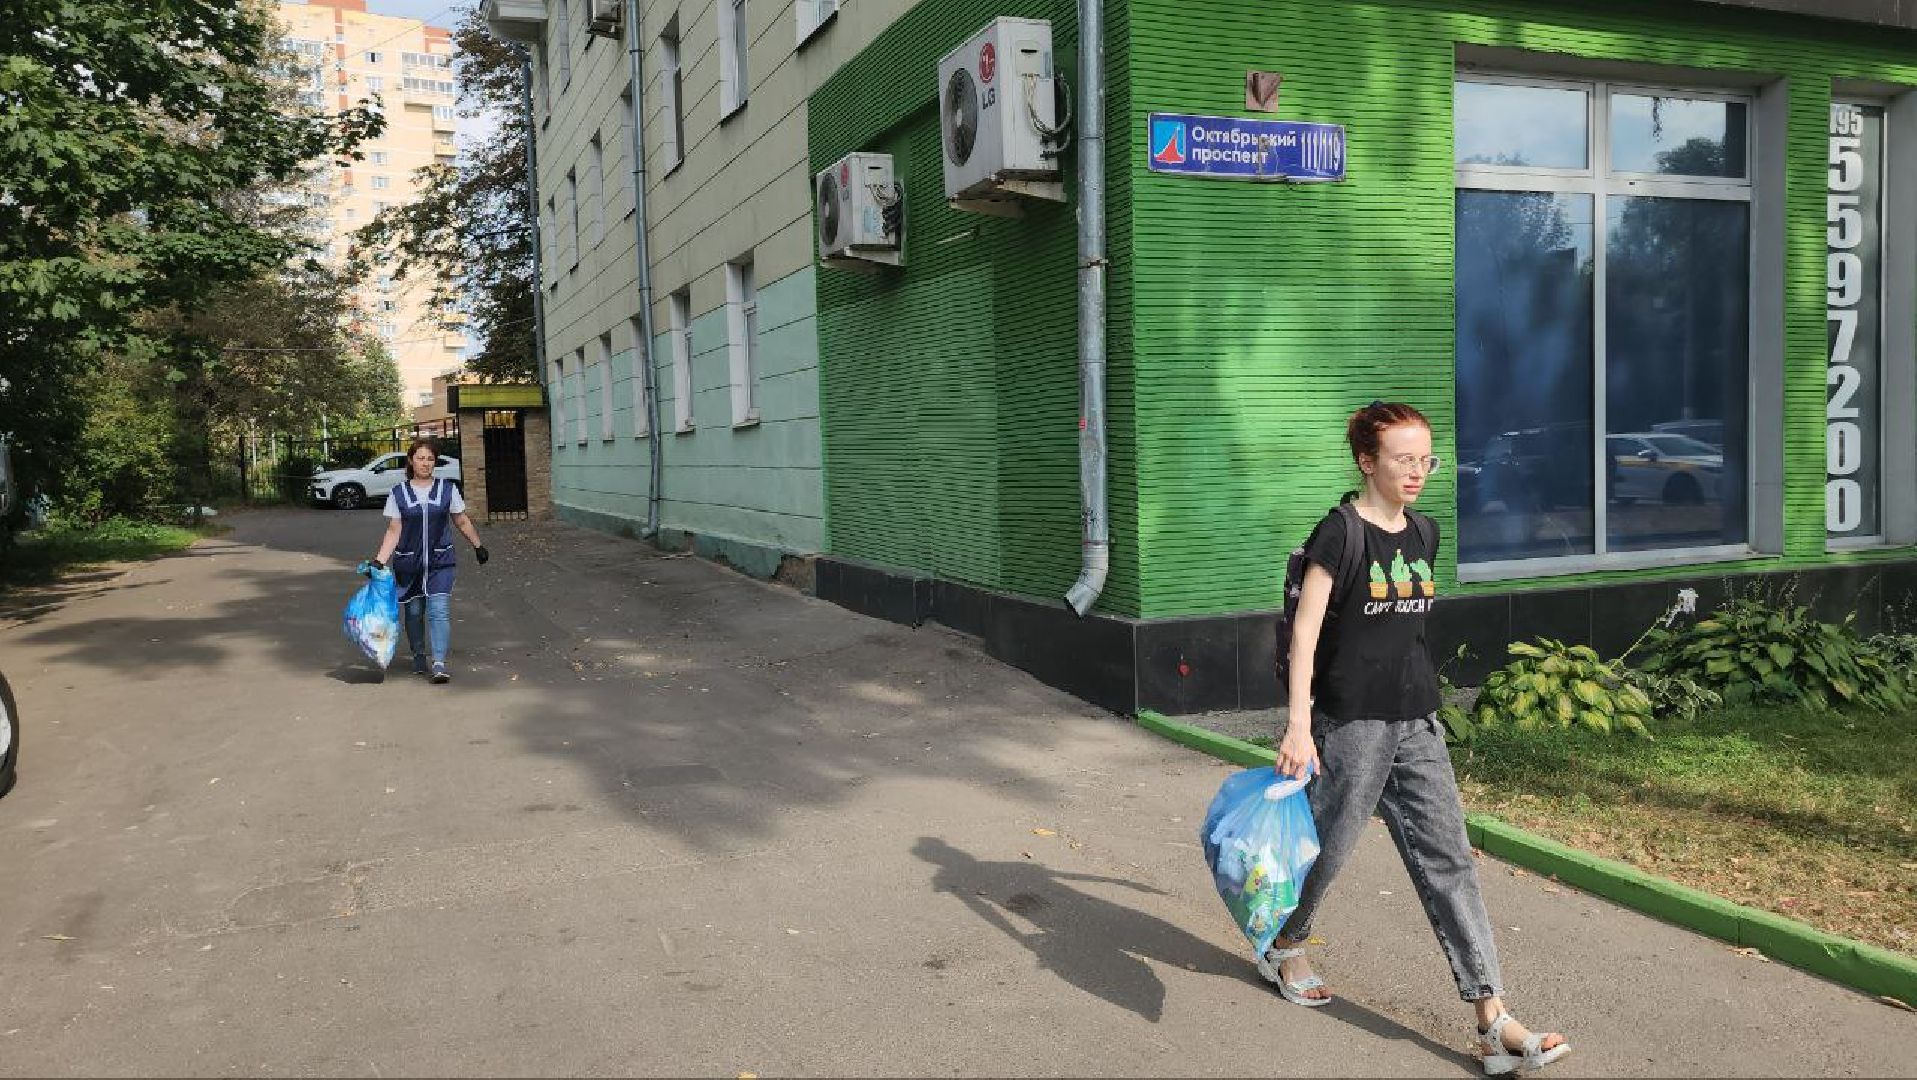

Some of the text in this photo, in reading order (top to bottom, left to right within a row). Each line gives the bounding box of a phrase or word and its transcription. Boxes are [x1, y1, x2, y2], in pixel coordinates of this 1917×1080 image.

[982, 88, 995, 110] LG
[1192, 125, 1296, 149] Октябрьский
[1192, 148, 1268, 164] проспект
[1395, 599, 1425, 613] TOUCH
